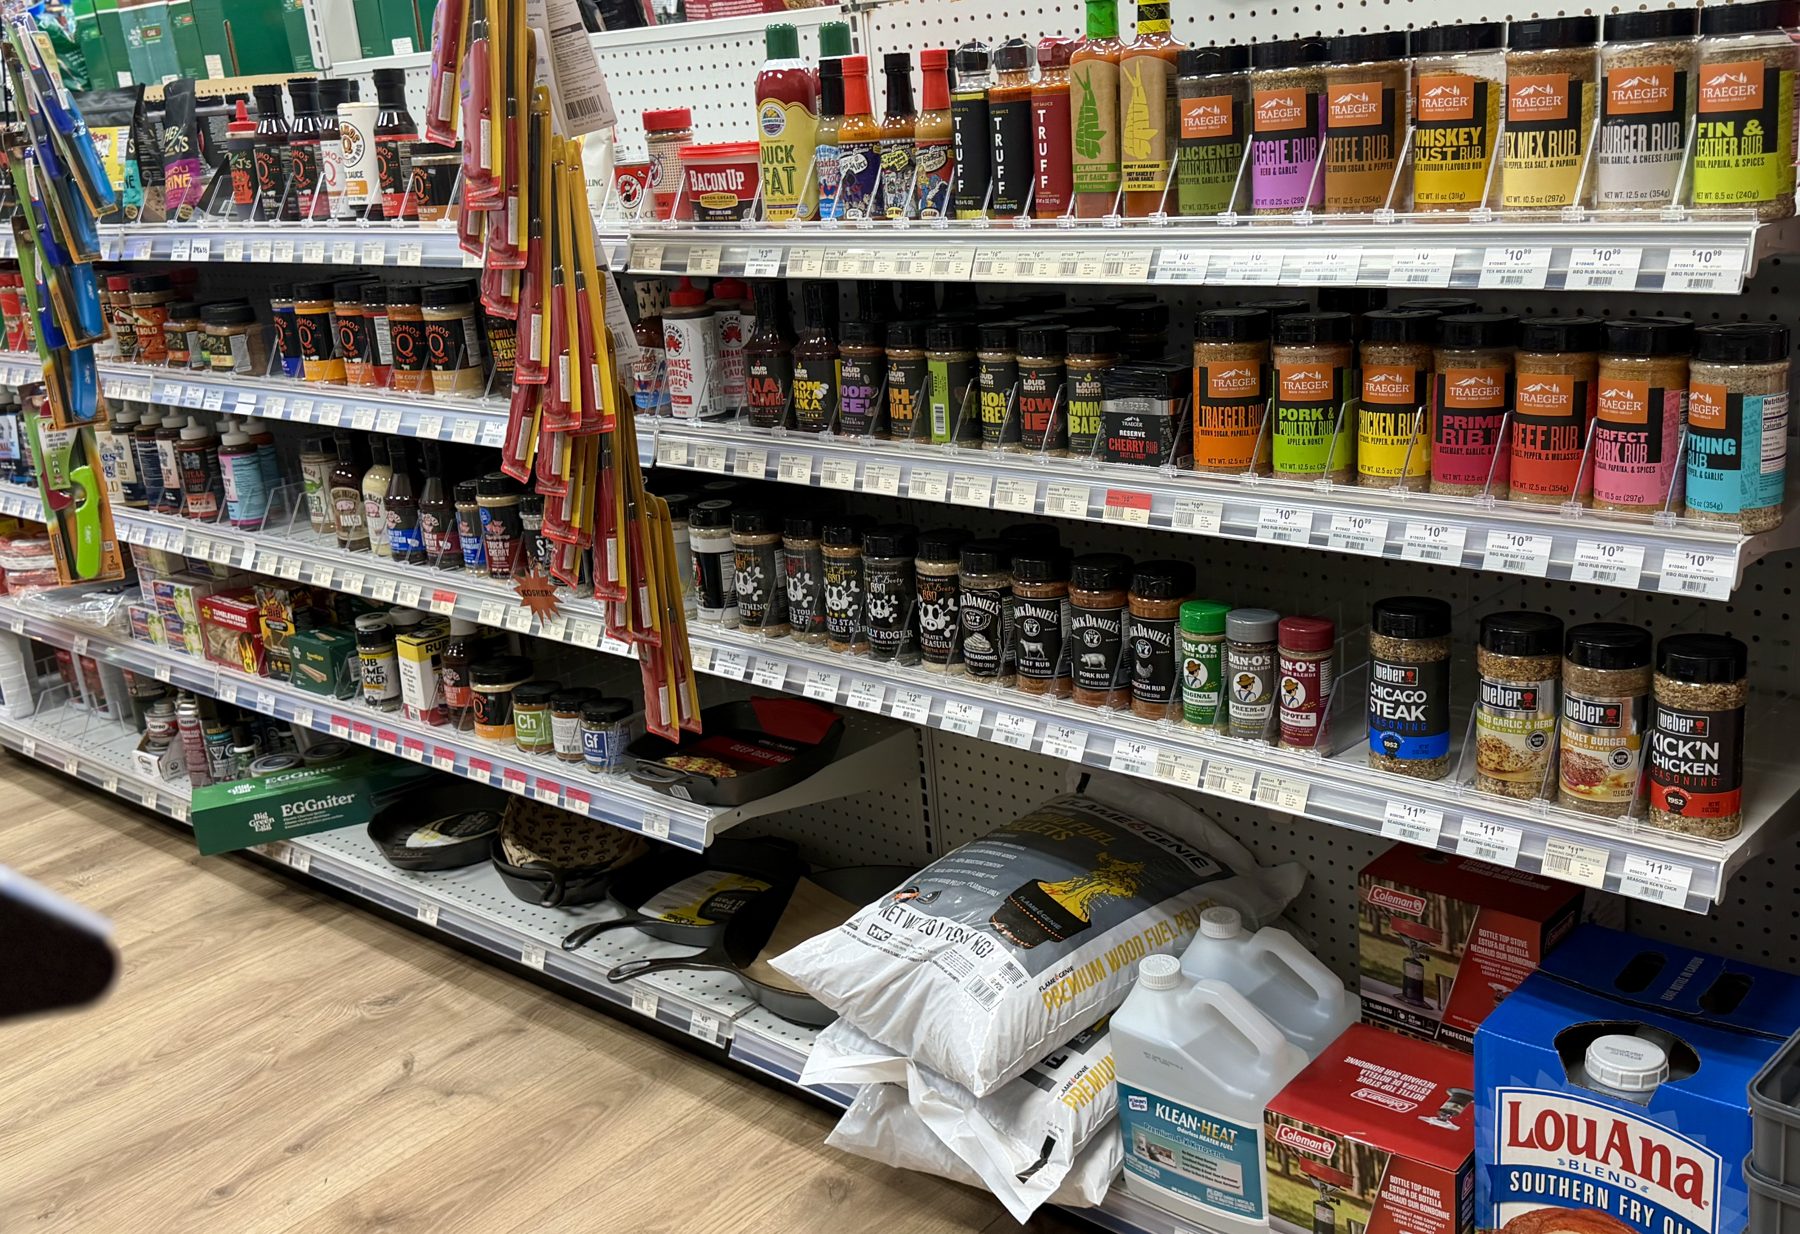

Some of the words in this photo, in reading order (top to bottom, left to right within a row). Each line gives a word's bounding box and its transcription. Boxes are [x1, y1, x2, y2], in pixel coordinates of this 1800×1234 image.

[1612, 87, 1668, 100] TRAEGER
[1702, 85, 1757, 97] TRAEGER
[1331, 103, 1377, 114] TRAEGER
[1421, 96, 1468, 108] TRAEGER
[1512, 96, 1562, 108] TRAEGER
[1184, 115, 1227, 125] TRAEGER
[1257, 106, 1300, 118] TRAEGER
[1698, 122, 1734, 137] FIN
[1744, 119, 1764, 135] &
[1416, 127, 1482, 147] WHISKEY
[1518, 131, 1545, 158] MEX
[1549, 129, 1577, 157] RUB
[1601, 123, 1647, 153] BURGER
[1651, 122, 1680, 151] RUB
[1038, 109, 1048, 188] TRUFF
[1292, 137, 1317, 164] RUB
[1363, 135, 1388, 161] RUB
[1415, 148, 1457, 161] DUST
[1460, 146, 1481, 160] RUB
[1696, 138, 1737, 157] FEATHER
[1742, 136, 1763, 155] RUB
[760, 145, 794, 165] DUCK
[955, 117, 964, 193] TRUFF
[994, 117, 1005, 194] TRUFF
[1556, 159, 1577, 167] PAPRIKA
[1639, 154, 1663, 164] CHEESE
[1278, 164, 1298, 175] GARLIC
[1374, 162, 1393, 170] PEPPER
[1706, 160, 1732, 169] PAPRIKA,
[1742, 158, 1765, 167] SPICES
[762, 166, 796, 195] FAT
[1212, 377, 1256, 388] TRAEGER
[1283, 380, 1329, 390] TRAEGER
[1365, 382, 1410, 393] TRAEGER
[1450, 386, 1500, 397] TRAEGER
[1520, 392, 1568, 404] TRAEGER
[1201, 406, 1245, 428] TRAEGER
[1279, 408, 1323, 421] PORK
[1328, 407, 1334, 419] &
[1119, 430, 1146, 438] RESERVE
[1279, 421, 1316, 436] POULTRY
[1319, 420, 1334, 435] RUB
[1371, 437, 1390, 445] PEPPER,
[1442, 428, 1483, 445] RIB
[1512, 423, 1547, 450] BEEF
[1551, 426, 1578, 450] RUB
[1109, 438, 1144, 452] CHERRY
[1524, 452, 1542, 460] PEPPER,
[1551, 453, 1580, 461] MOLASSES
[1625, 444, 1647, 463] RUB
[1637, 466, 1656, 474] SPICES
[1704, 472, 1723, 481] GARLIC
[1623, 494, 1644, 503] (297g)
[1025, 603, 1059, 623] DANIEL'S
[1086, 614, 1121, 634] DANIEL'S
[1138, 623, 1172, 647] DANIEL'S
[1229, 651, 1270, 666] DAN-O'S
[1376, 664, 1405, 682] weber
[1370, 682, 1427, 703] CHICAGO
[1482, 683, 1522, 709] weber
[1370, 696, 1427, 721] STEAK
[1566, 698, 1604, 723] weber
[518, 714, 537, 730] Ch
[1493, 718, 1523, 729] GARLIC
[1534, 719, 1553, 728] HERB
[1660, 713, 1694, 733] weber
[584, 732, 598, 748] Gf
[1591, 737, 1627, 746] BURGER
[1652, 729, 1719, 761] KICK'N
[1652, 752, 1719, 776] CHICKEN
[280, 793, 356, 817] EGGniter
[1668, 797, 1685, 805] 1952
[249, 817, 275, 827] Green
[1373, 888, 1414, 909] Coleman
[1479, 929, 1498, 940] BOTTLE
[1510, 937, 1527, 948] STOVE
[1496, 952, 1508, 960] SUR
[1507, 946, 1529, 958] BOTELLA
[1043, 957, 1105, 1015] PREMIUM
[1105, 936, 1146, 973] WOOD
[1145, 919, 1178, 948] FUEL
[1039, 977, 1057, 993] FLAME
[1059, 965, 1074, 979] GENIE
[1074, 1065, 1089, 1079] GENIE
[1344, 1056, 1385, 1073] BONBONNE
[1360, 1068, 1392, 1082] BOTELLA
[1384, 1069, 1401, 1077] SUR
[1356, 1076, 1383, 1088] STOVE
[1381, 1084, 1397, 1093] TOP
[1402, 1082, 1432, 1095] ESTUFA
[1397, 1088, 1426, 1101] BOTTLE
[1220, 1141, 1233, 1151] FUEL
[1281, 1127, 1323, 1150] Coleman
[1569, 1159, 1637, 1190] BLEND
[1390, 1175, 1410, 1188] BOTTLE
[1411, 1182, 1422, 1191] TOP
[1422, 1185, 1440, 1198] STOVE
[1389, 1184, 1409, 1199] ESTUFA
[1419, 1194, 1442, 1208] BOTELLA
[1510, 1171, 1609, 1209] SOUTHERN
[1619, 1195, 1654, 1227] FRY
[1408, 1198, 1420, 1209] SUR
[1420, 1203, 1450, 1220] BONBONNE
